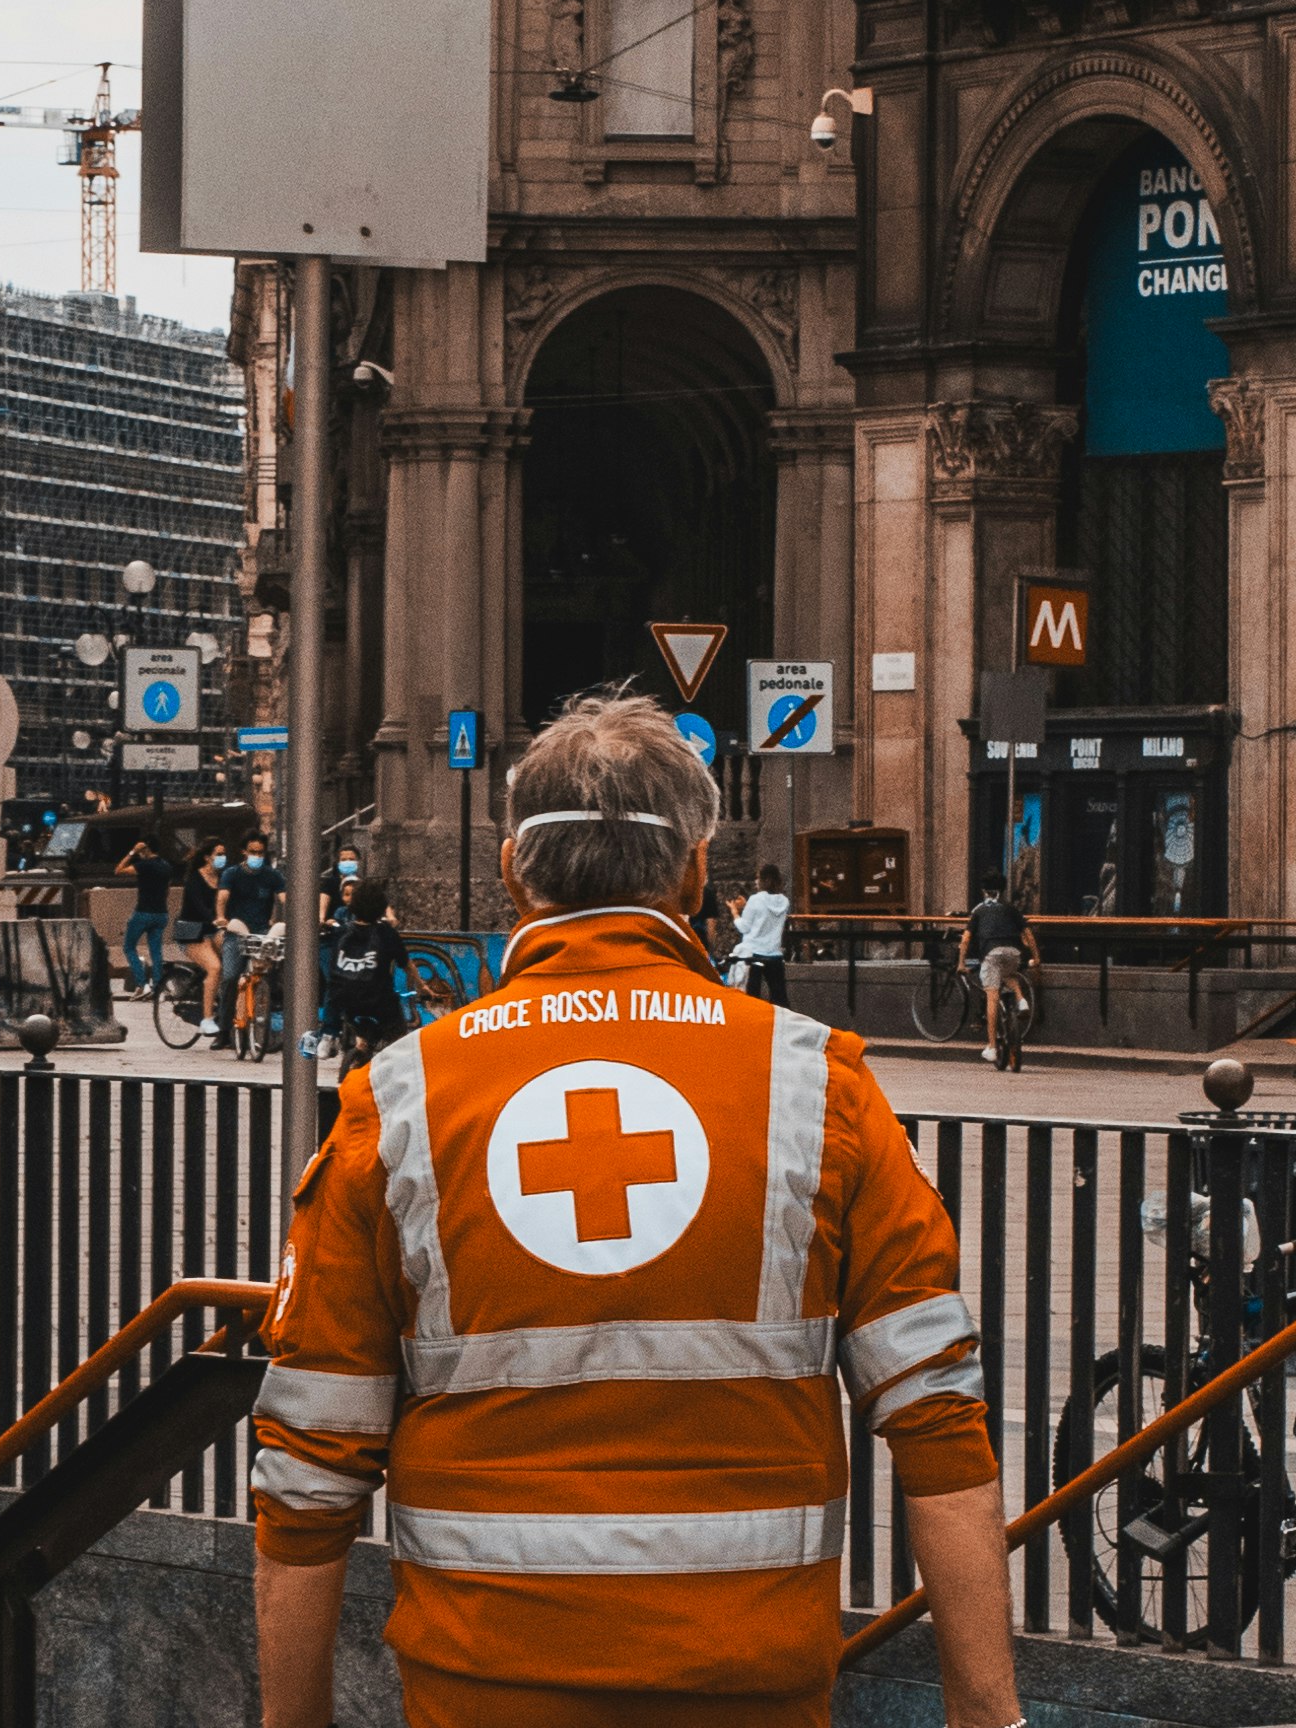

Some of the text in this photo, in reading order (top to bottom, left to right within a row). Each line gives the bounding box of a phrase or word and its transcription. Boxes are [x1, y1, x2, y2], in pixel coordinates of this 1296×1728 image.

[1030, 600, 1082, 651] M
[150, 654, 173, 663] area
[776, 665, 807, 675] area
[759, 677, 824, 692] pedonale
[1070, 738, 1102, 758] POINT
[459, 989, 726, 1039] CROCE ROSSA ITALIANA
